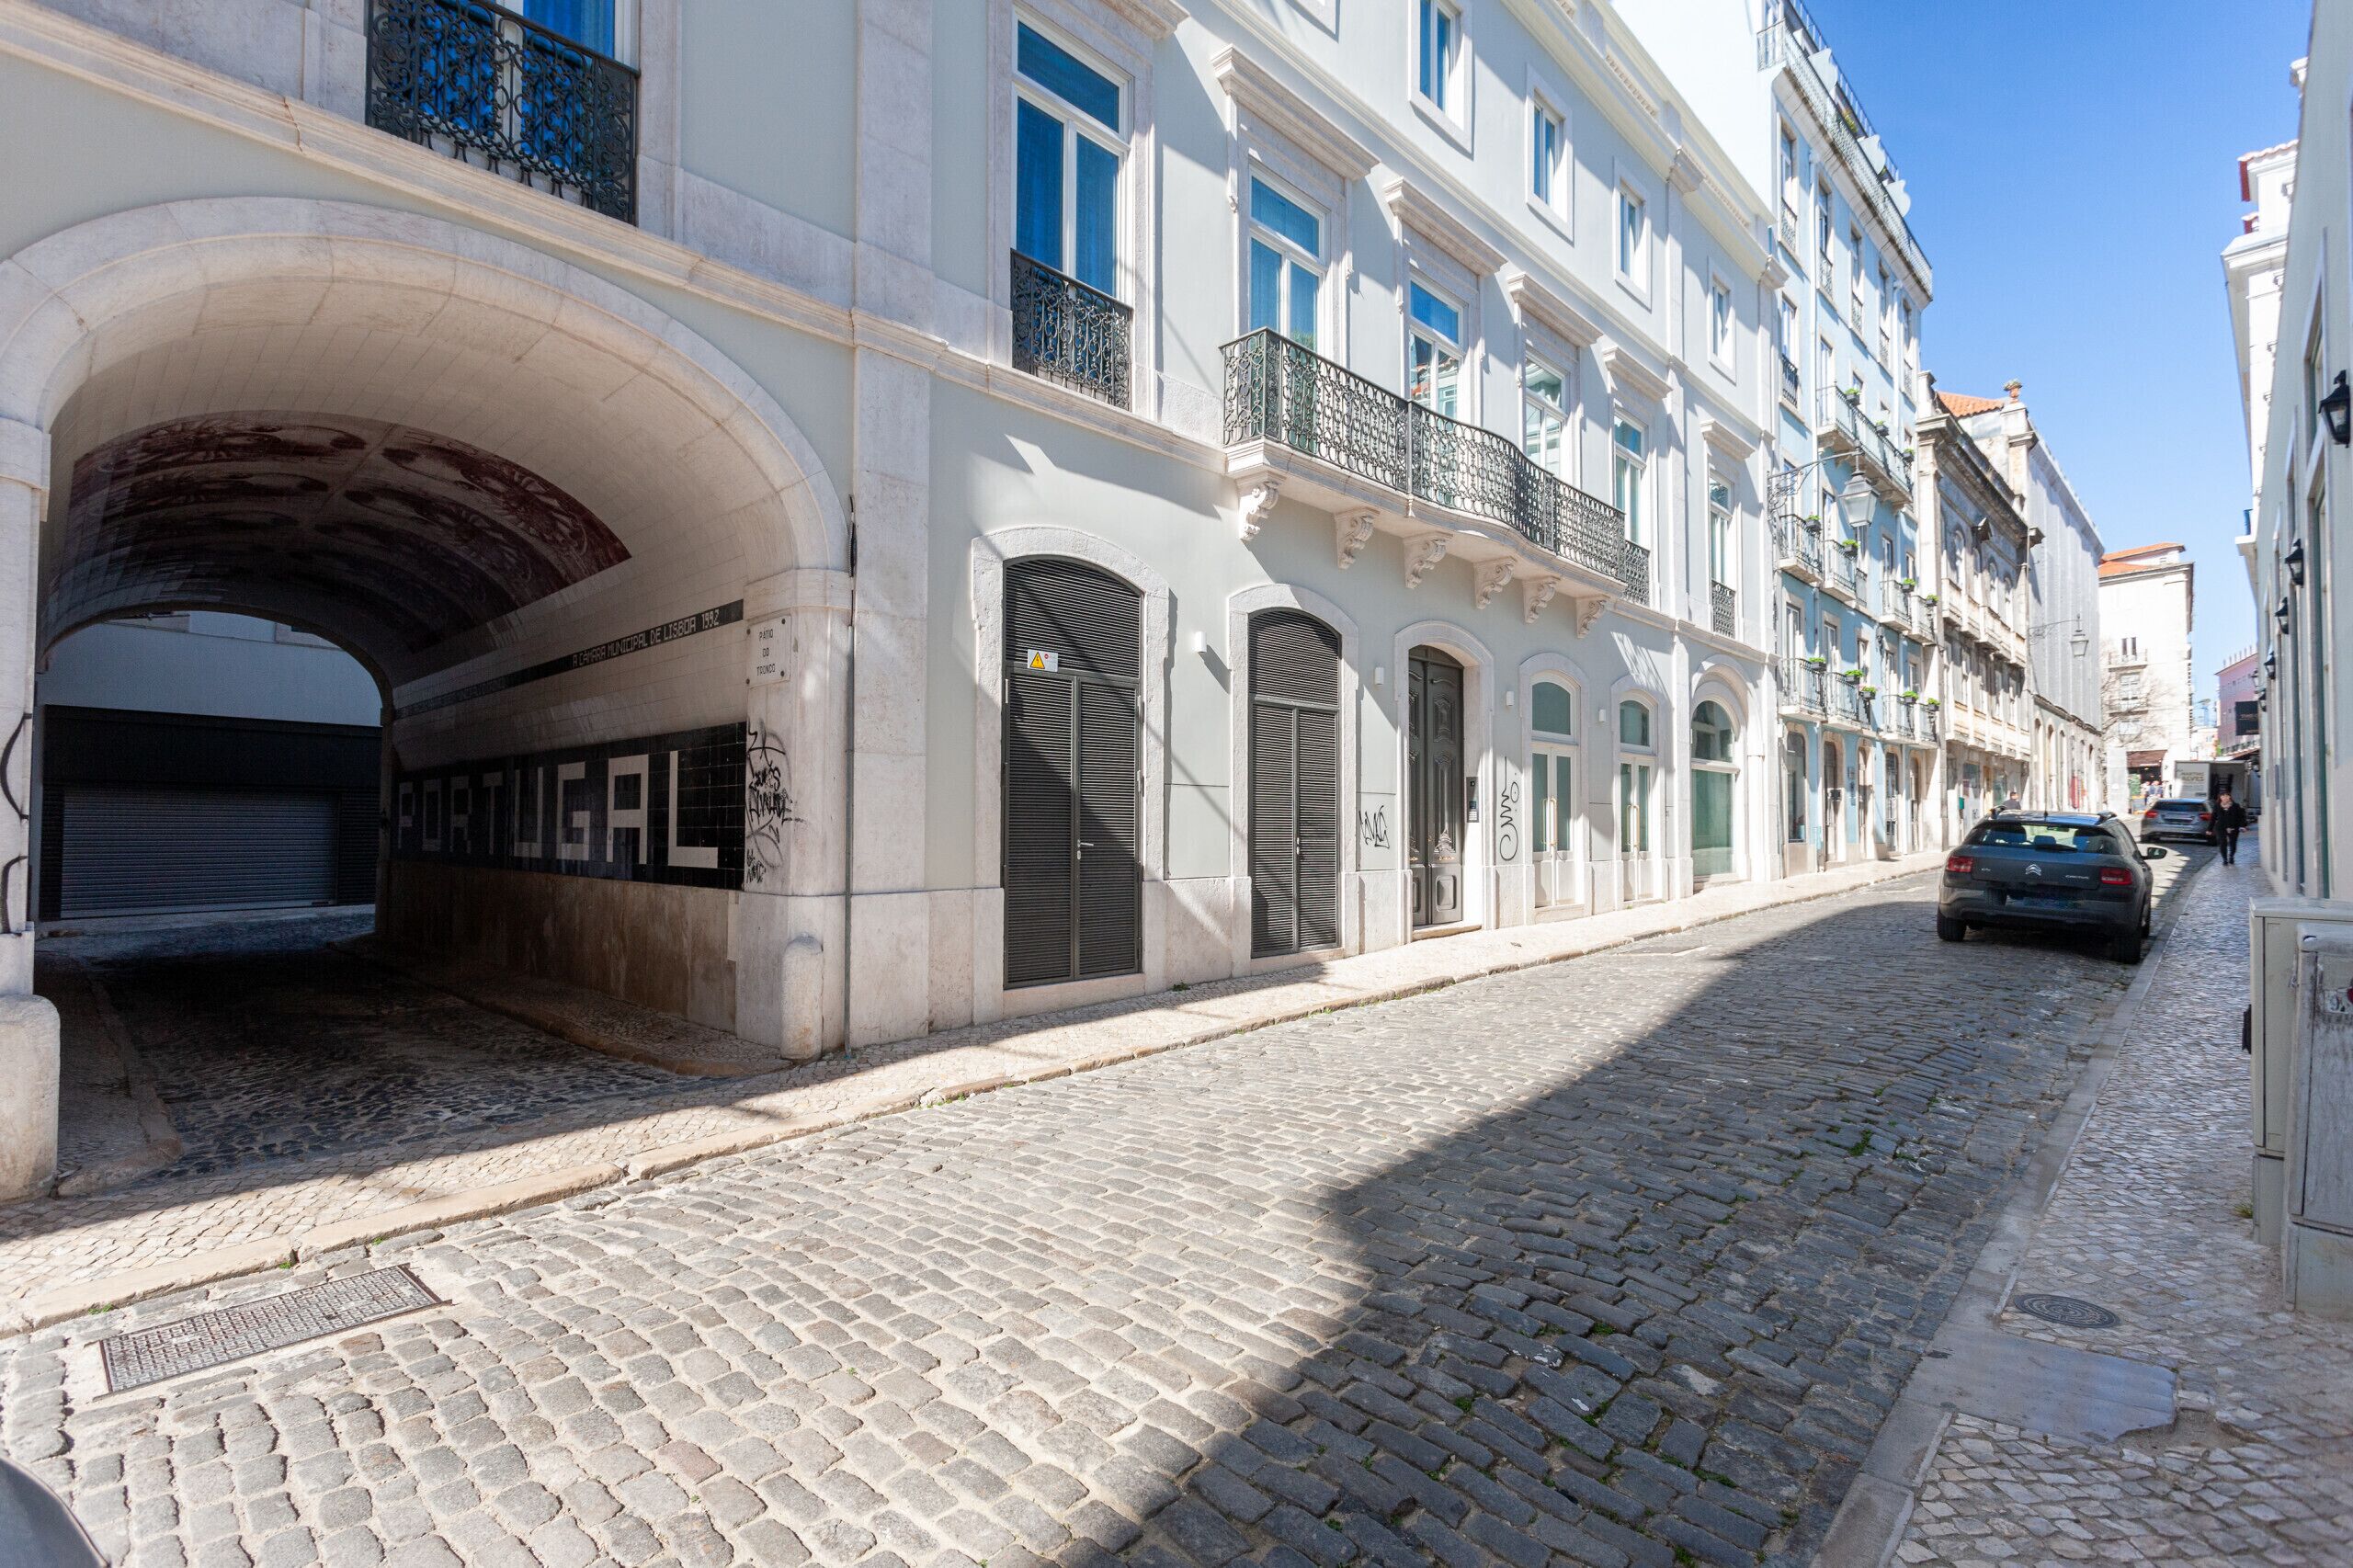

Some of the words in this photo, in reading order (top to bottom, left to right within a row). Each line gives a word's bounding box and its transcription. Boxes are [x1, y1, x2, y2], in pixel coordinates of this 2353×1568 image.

[608, 632, 648, 657] MUNICIPAL
[650, 627, 662, 646] DE
[664, 616, 697, 641] LISBOA
[701, 608, 720, 631] 1992
[758, 628, 774, 642] PÁTIO
[762, 647, 770, 657] DO
[756, 663, 776, 676] TRONCO
[398, 750, 719, 869] PORTUGAL
